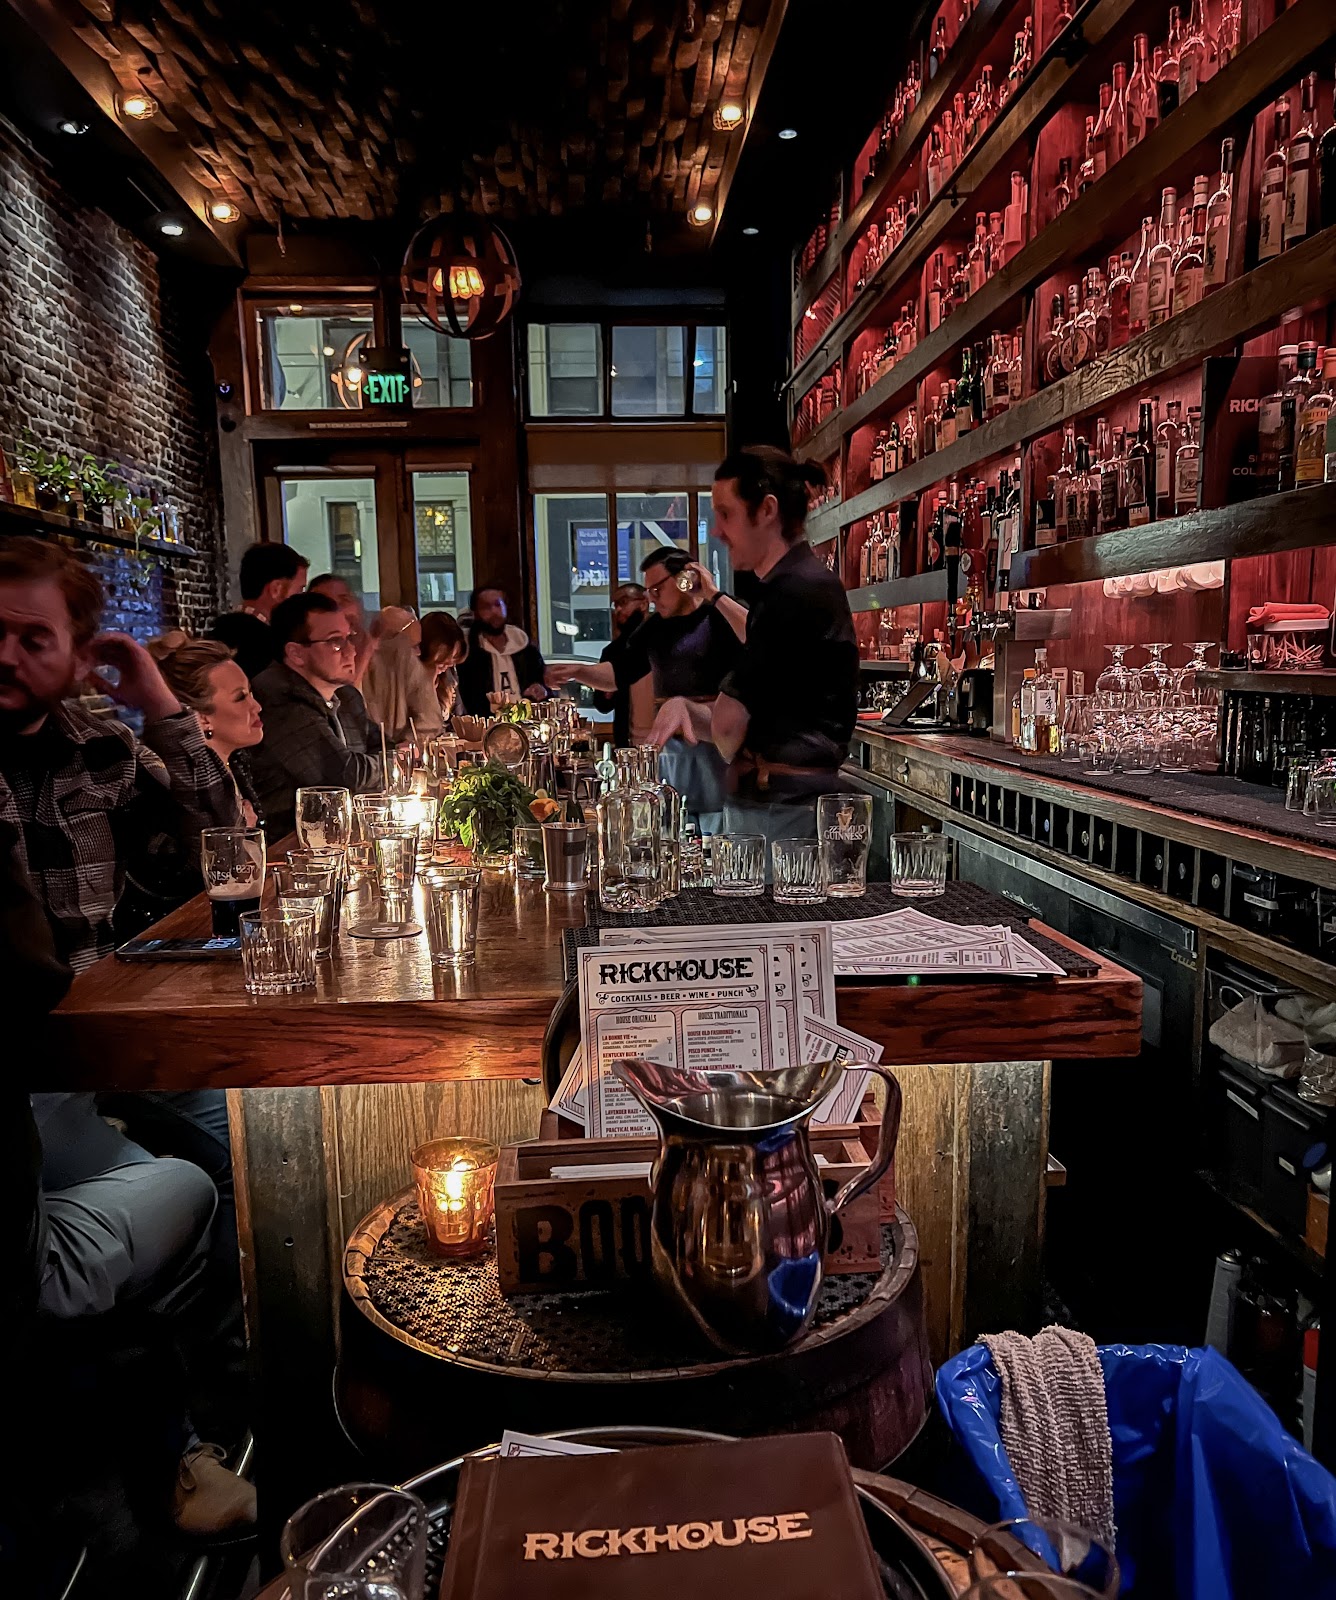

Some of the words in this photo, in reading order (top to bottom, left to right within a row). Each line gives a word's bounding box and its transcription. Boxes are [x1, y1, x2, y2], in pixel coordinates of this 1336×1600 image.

[368, 374, 405, 403] EXIT
[824, 829, 863, 840] GUINNESS
[599, 957, 754, 985] RICKHOUSE
[610, 994, 652, 1003] COCKTAILS
[688, 991, 709, 999] WINE
[717, 989, 744, 998] PUNCH
[616, 1015, 632, 1025] HOUSE
[632, 1014, 657, 1023] ORIGINALS
[697, 1011, 713, 1020] HOUSE
[714, 1009, 748, 1019] TRADITIONALS
[524, 1512, 813, 1560] RICKHOUSE
